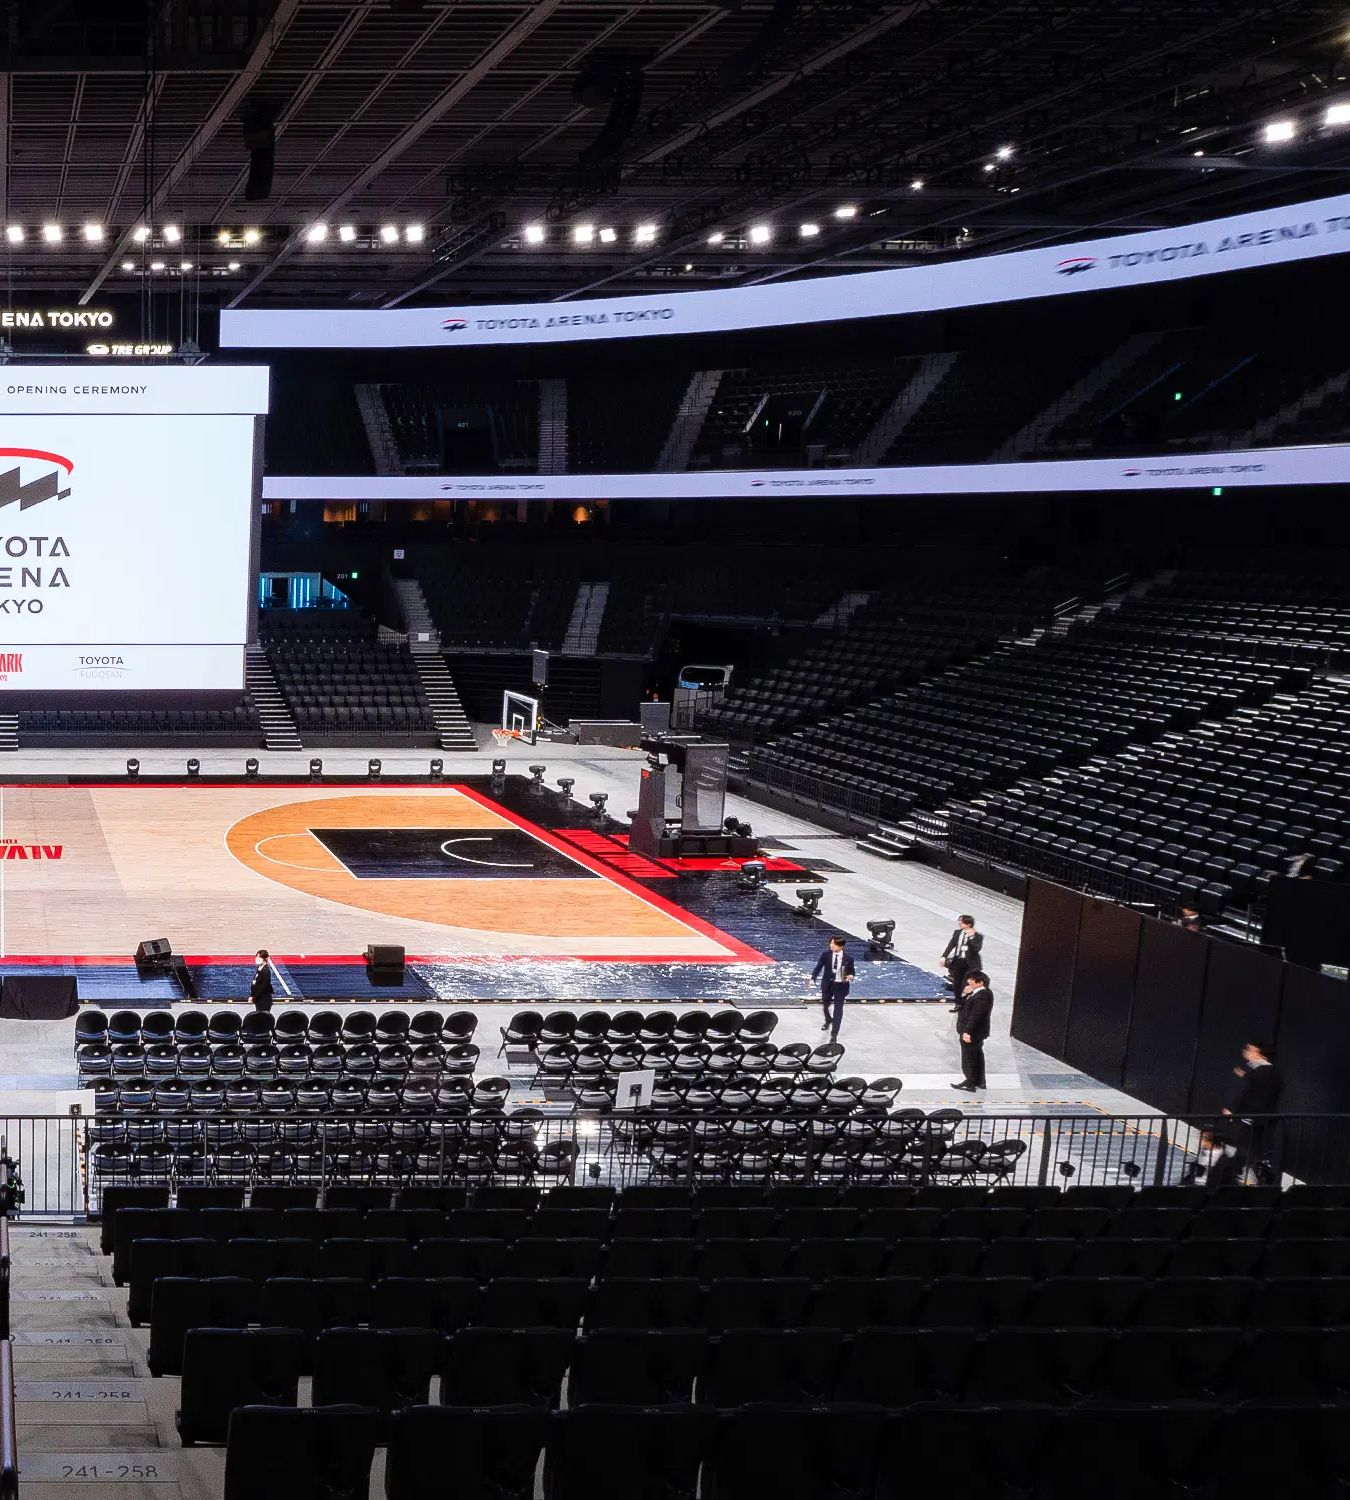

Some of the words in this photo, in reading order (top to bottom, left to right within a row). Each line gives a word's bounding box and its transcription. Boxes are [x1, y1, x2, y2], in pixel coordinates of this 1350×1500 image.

[1107, 241, 1209, 269] TOYOTA
[1216, 221, 1318, 253] ARENA
[48, 312, 113, 326] TOKYO
[474, 318, 541, 331] TOYOTA
[546, 312, 610, 328] ARENA
[613, 308, 675, 323] TOKYO
[111, 344, 134, 355] TRE
[134, 344, 173, 355] GROUP
[7, 385, 67, 394] OPENING
[73, 385, 148, 394] CEREMONY
[78, 656, 124, 665] TOYOTA
[79, 670, 123, 679] FUDOSAN
